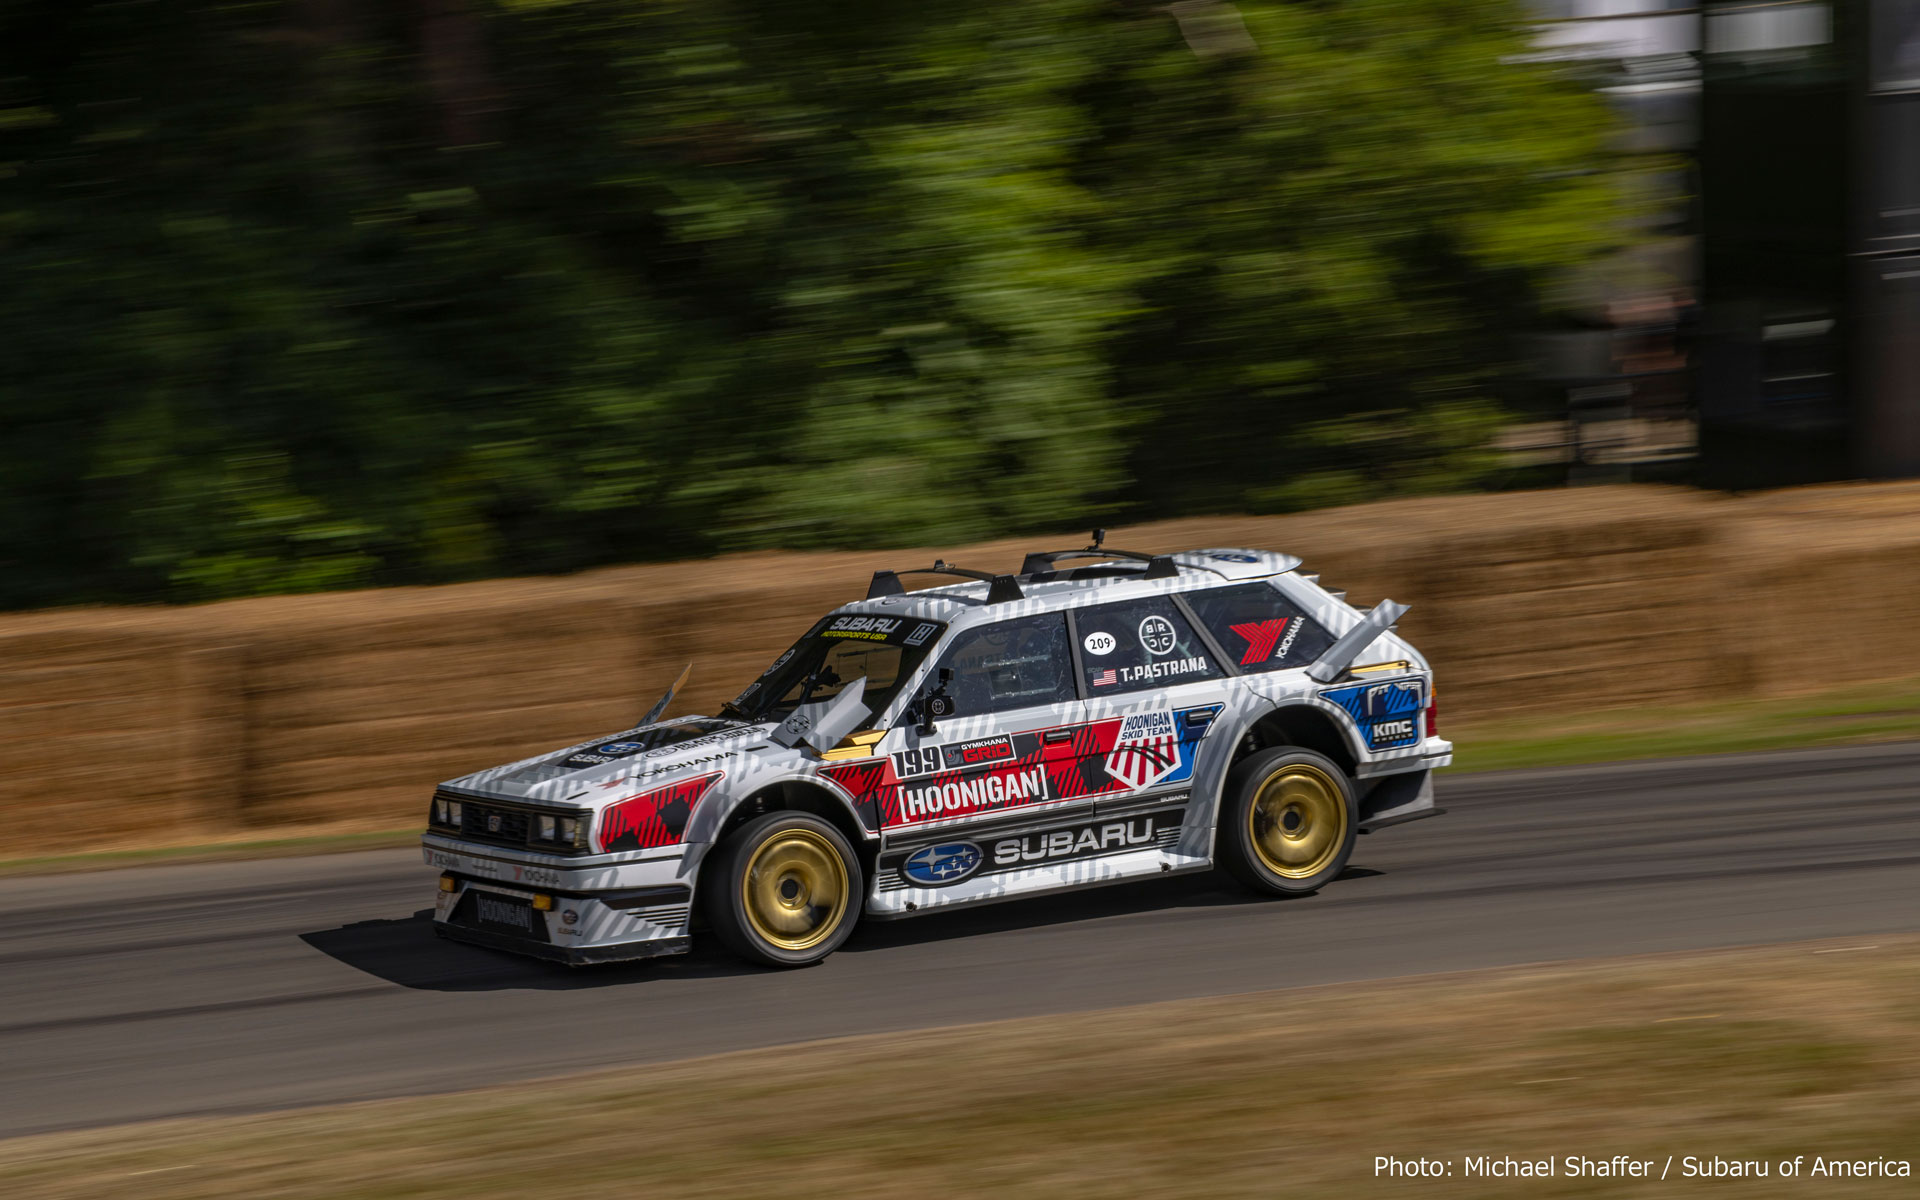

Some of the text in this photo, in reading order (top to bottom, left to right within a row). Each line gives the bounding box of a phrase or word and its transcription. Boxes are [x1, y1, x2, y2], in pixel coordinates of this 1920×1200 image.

[829, 616, 903, 634] SUBARU
[821, 630, 888, 641] MOTORSPORTS USA
[1090, 637, 1110, 650] 209
[1275, 616, 1305, 659] YOKOHAMA
[1124, 711, 1171, 731] HOONIGAN
[1121, 726, 1172, 741] SKID TEAM
[960, 737, 1008, 750] GYMKHANA
[628, 751, 739, 780] YOKOHAMA
[891, 746, 941, 778] 199
[994, 818, 1154, 865] SUBARU
